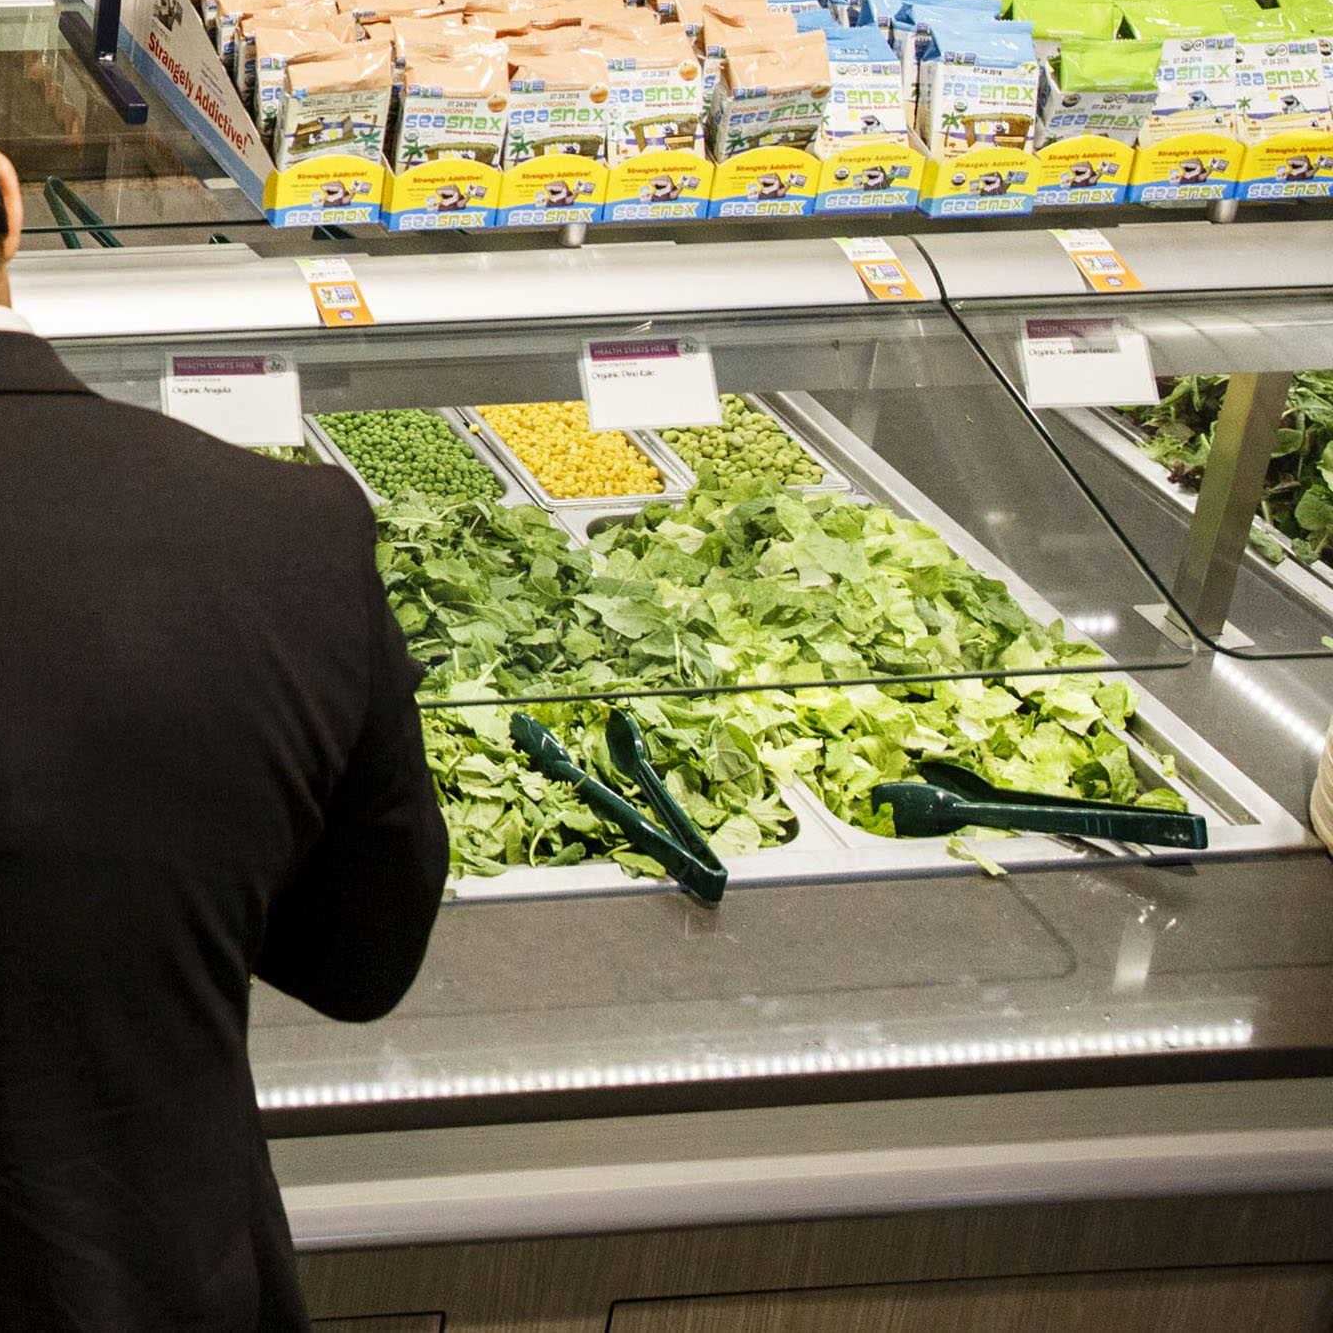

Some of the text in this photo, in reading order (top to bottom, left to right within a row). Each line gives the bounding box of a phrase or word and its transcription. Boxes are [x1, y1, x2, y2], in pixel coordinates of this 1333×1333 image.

[148, 31, 249, 155] Strangely Addictive!
[609, 84, 698, 104] seasnax
[942, 82, 1034, 101] seasnax
[405, 114, 501, 131] seasnax
[730, 100, 828, 126] seasnax
[825, 189, 909, 209] seasnax
[1142, 183, 1224, 202] seasnax
[285, 207, 370, 226] seasnax
[399, 211, 488, 231] seasnax
[613, 201, 699, 221] seasnax
